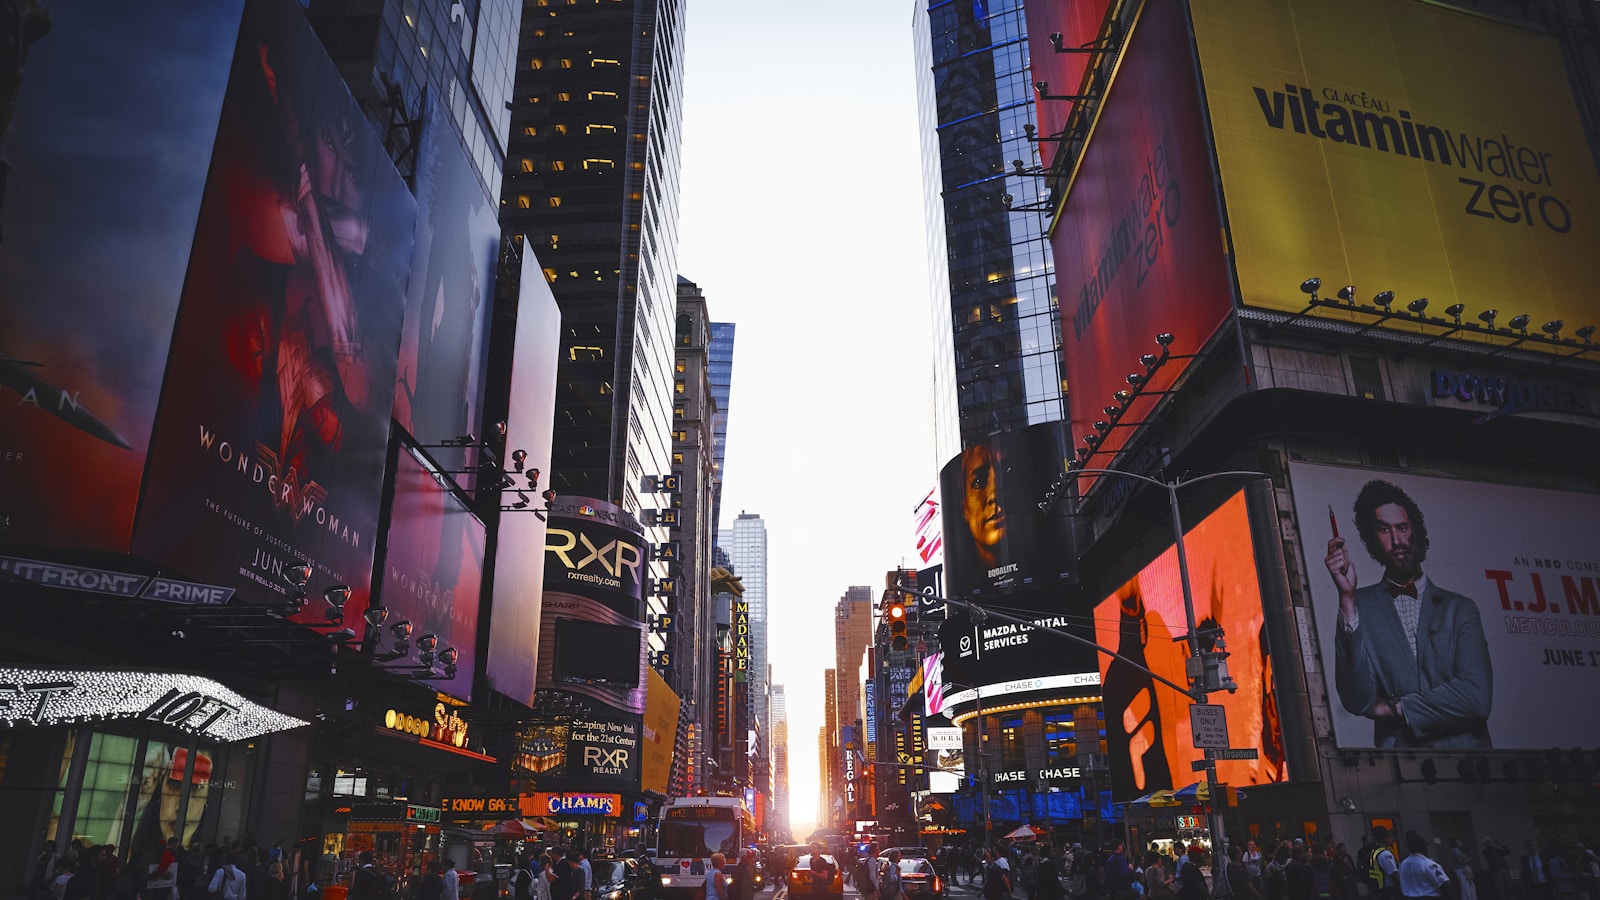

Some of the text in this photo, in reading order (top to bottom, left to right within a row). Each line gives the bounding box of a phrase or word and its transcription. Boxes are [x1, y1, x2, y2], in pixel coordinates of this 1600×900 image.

[1252, 82, 1554, 188] vitaminwater
[1458, 176, 1572, 235] zero
[1132, 181, 1181, 290] zero
[1431, 367, 1505, 405] DOW
[200, 425, 360, 548] WONDER WOMAN
[205, 499, 220, 513] THE
[223, 509, 251, 531] FUTURE
[254, 526, 264, 537] OF
[265, 534, 291, 553] JUSTICE
[252, 548, 288, 578] JUN
[545, 528, 641, 585] RXR
[1514, 557, 1529, 567] AN
[1534, 558, 1561, 569] HBO
[987, 563, 1018, 578] EQUALITY.
[567, 572, 620, 588] rxrrealty.com
[154, 581, 225, 605] PRIME
[392, 566, 438, 609] WONDER
[442, 602, 475, 631] WOMAN
[1484, 569, 1561, 613] T.J.
[542, 601, 580, 610] SHARP
[736, 602, 748, 669] MADAME
[983, 623, 1017, 640] MAZDA
[983, 633, 1029, 651] SERVICES
[1543, 648, 1586, 667] JUNE
[1005, 680, 1033, 692] CHASE
[142, 687, 239, 734] LOFT
[1196, 707, 1219, 716] BUSES
[607, 722, 623, 733] New
[623, 723, 635, 735] York
[867, 716, 876, 742] STUDIOS
[1200, 717, 1216, 726] ONLY
[572, 731, 636, 748] for the 21st Century
[912, 713, 924, 775] NW VICTORY
[583, 746, 629, 769] RXR
[1224, 750, 1256, 760] Broadway
[593, 766, 622, 775] REALTY
[845, 750, 854, 802] REGAL
[898, 769, 906, 785] NEW
[995, 770, 1026, 783] CHASE
[1039, 767, 1081, 780] CHASE
[452, 798, 485, 811] KNOW
[548, 796, 614, 813] CHAMPS
[1179, 816, 1200, 828] SODA
